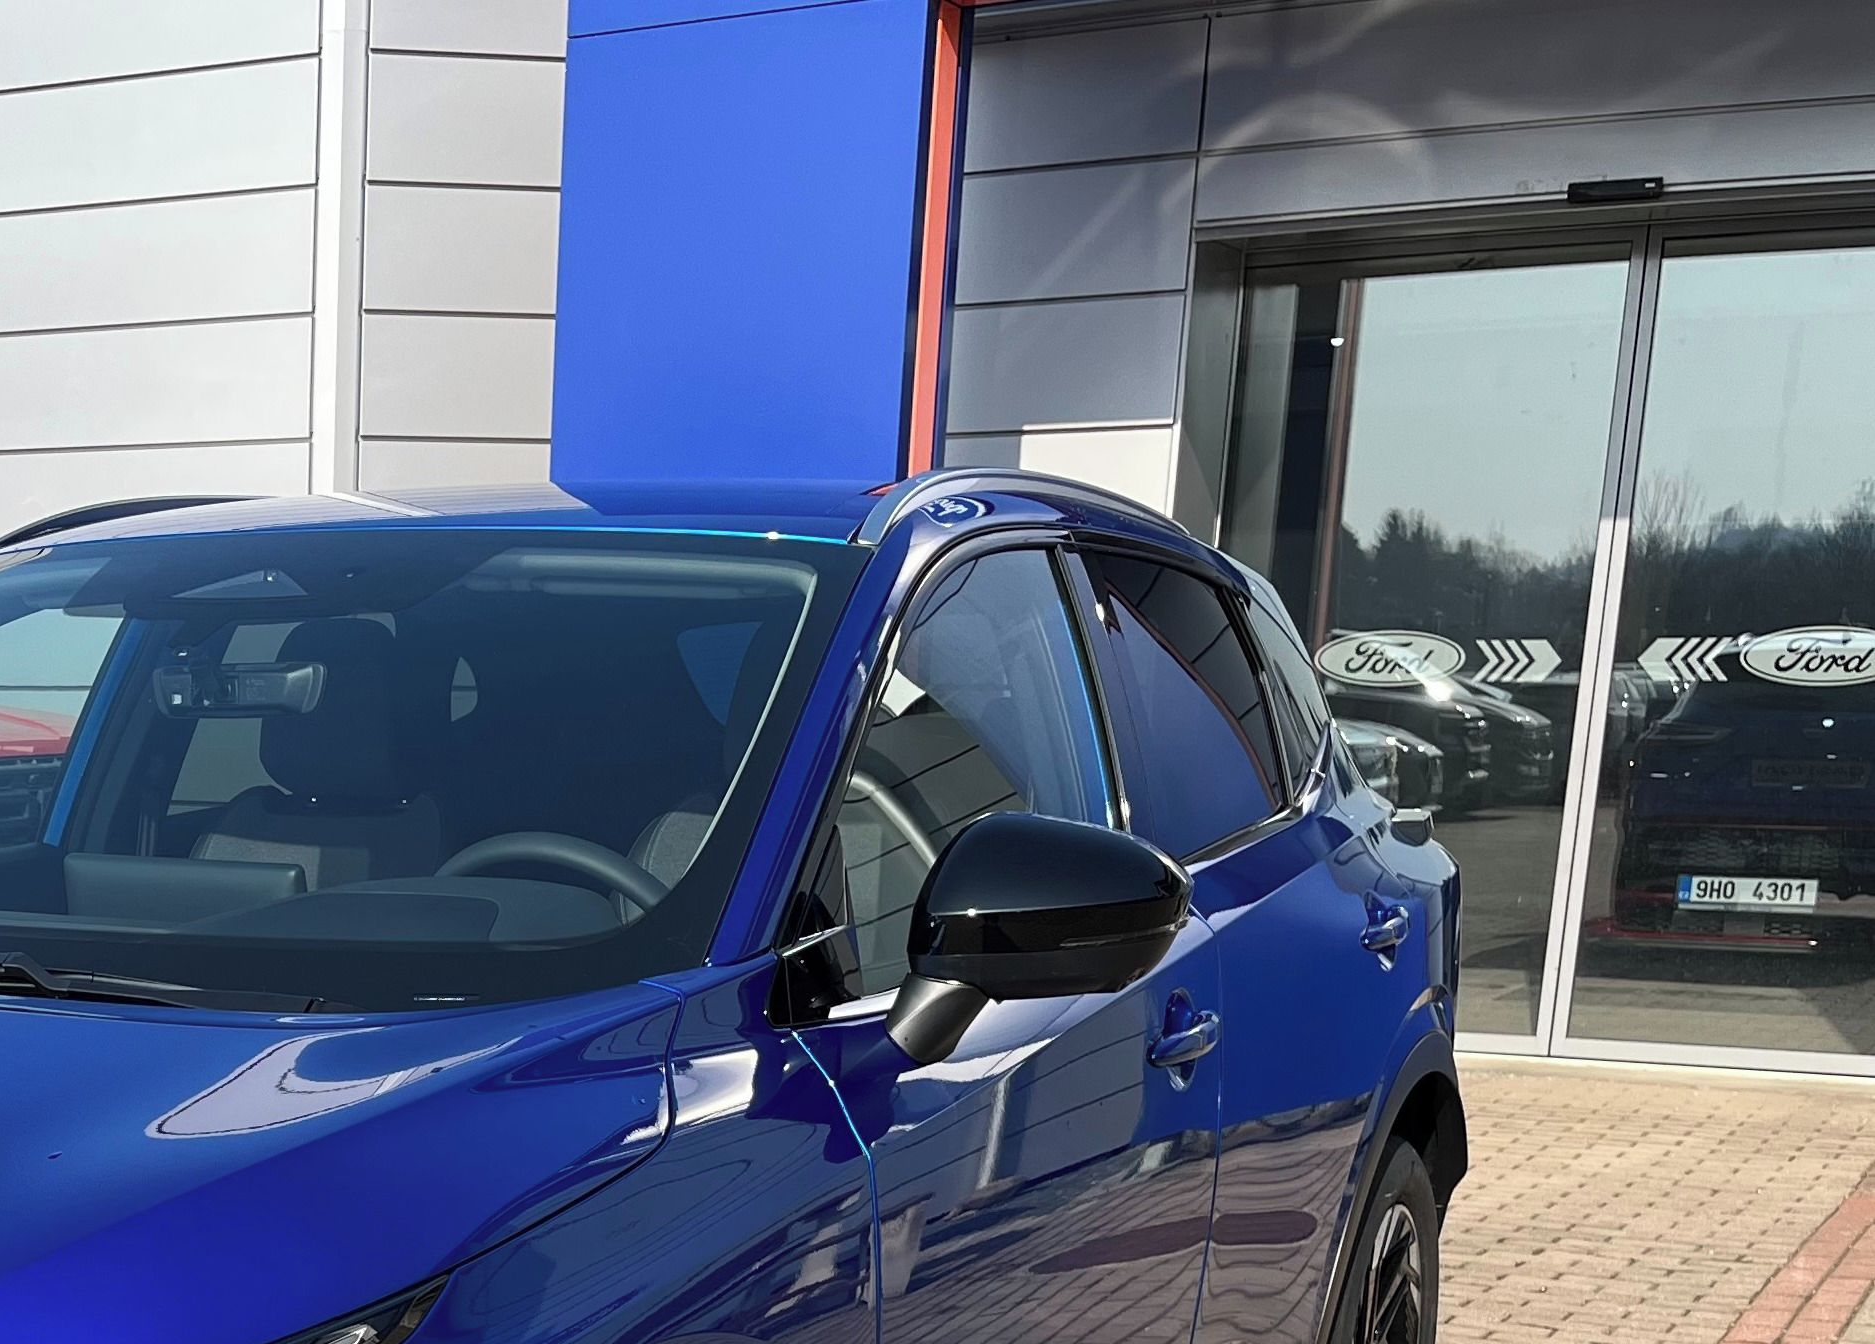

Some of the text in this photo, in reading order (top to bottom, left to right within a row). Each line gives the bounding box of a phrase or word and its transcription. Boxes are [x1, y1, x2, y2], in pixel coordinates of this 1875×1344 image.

[1344, 640, 1435, 674] Ford
[1774, 637, 1875, 673] Ford
[1752, 881, 1806, 901] 4301
